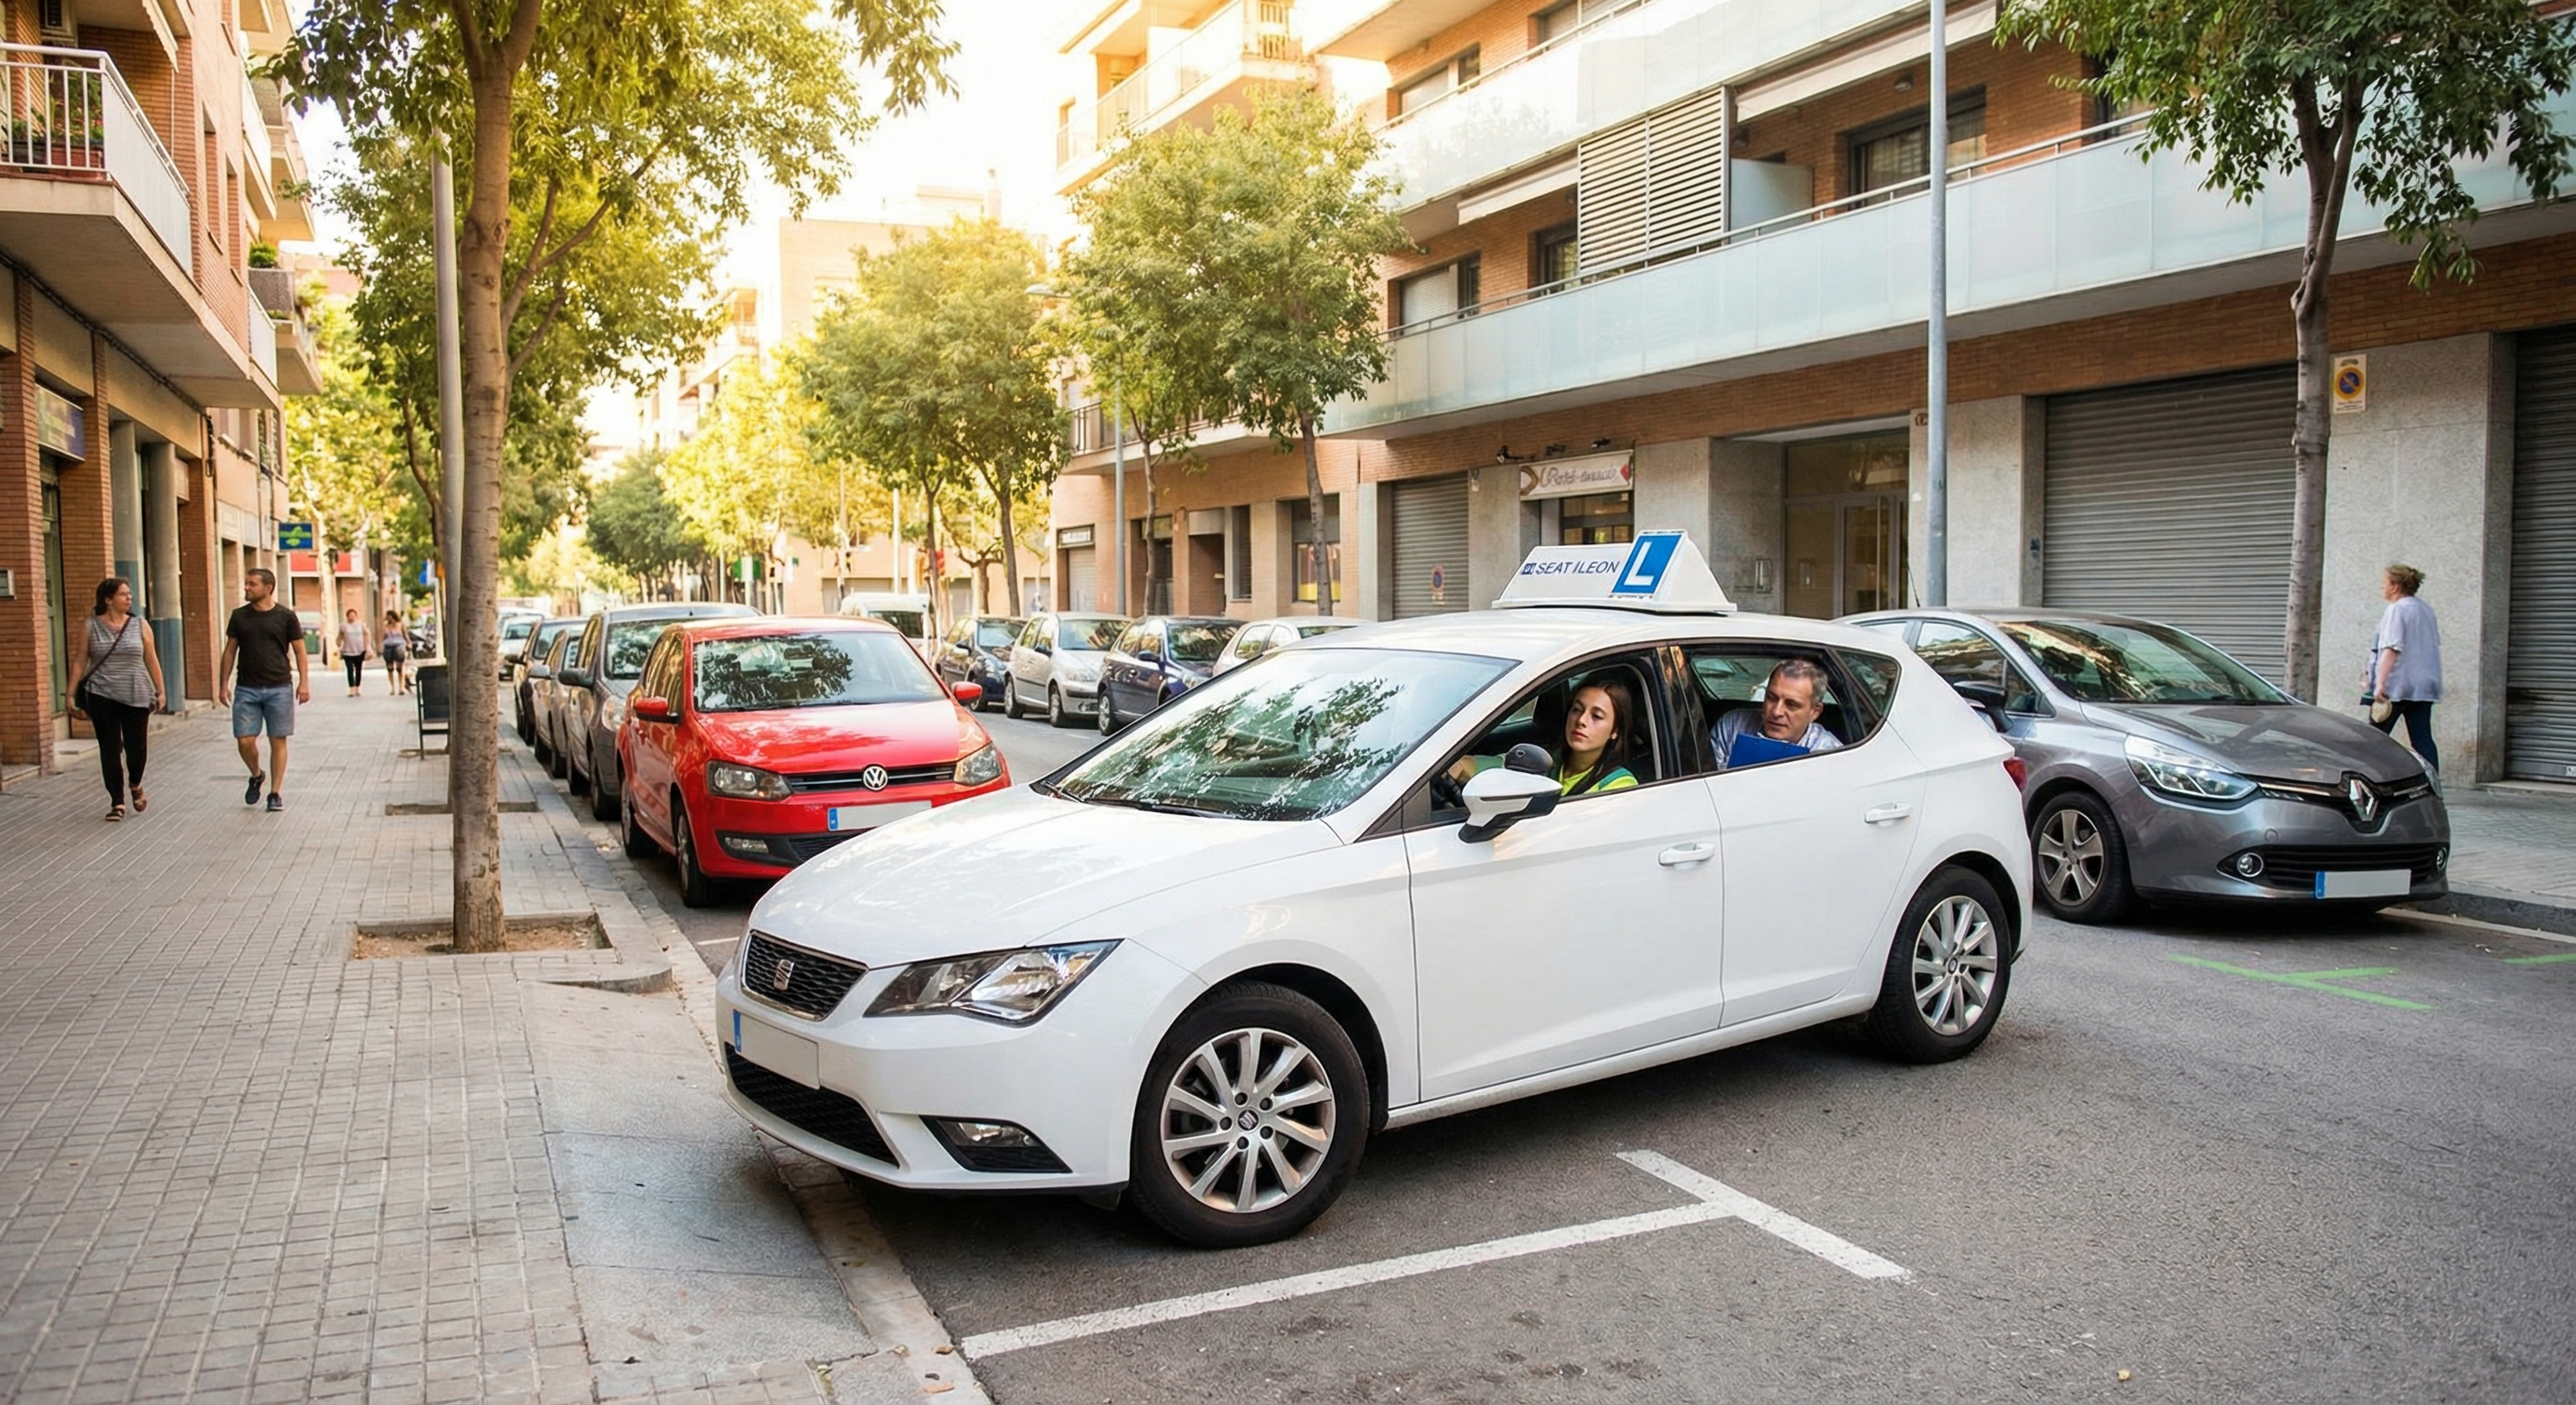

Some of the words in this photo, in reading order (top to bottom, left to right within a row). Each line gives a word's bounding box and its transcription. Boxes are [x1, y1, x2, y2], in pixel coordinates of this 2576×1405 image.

[1536, 562, 1573, 574] SEAT
[1623, 541, 1654, 585] L
[864, 766, 887, 790] VW
